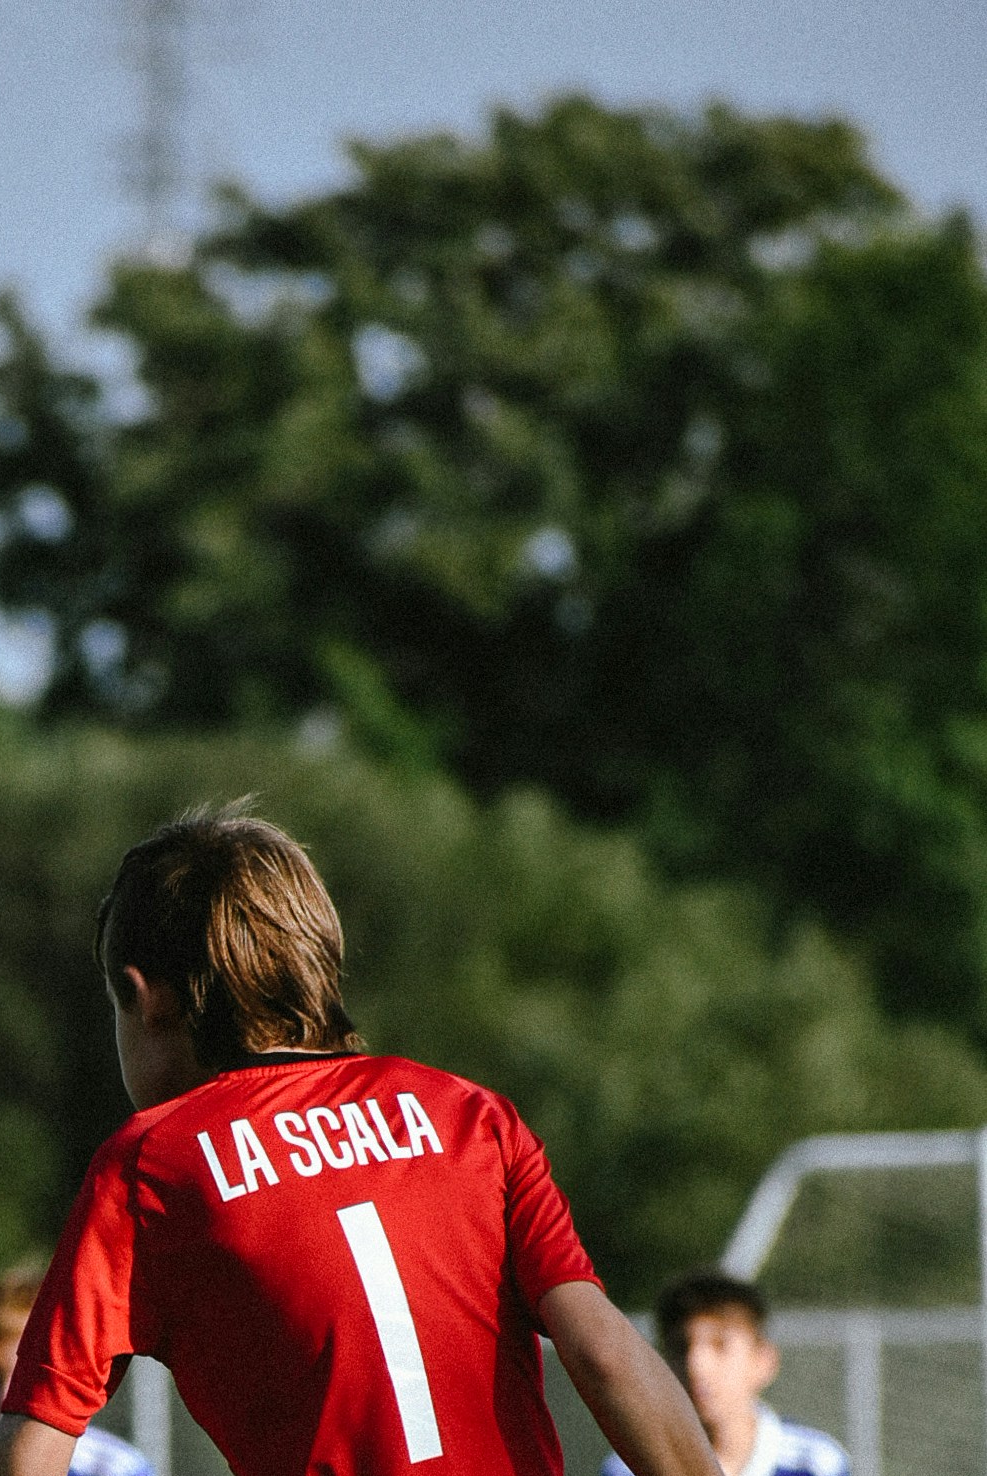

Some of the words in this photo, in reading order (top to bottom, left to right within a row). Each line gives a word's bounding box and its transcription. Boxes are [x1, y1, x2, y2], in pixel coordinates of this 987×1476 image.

[197, 1118, 280, 1202] LA
[273, 1092, 444, 1177] SCALA
[336, 1201, 443, 1464] 1
